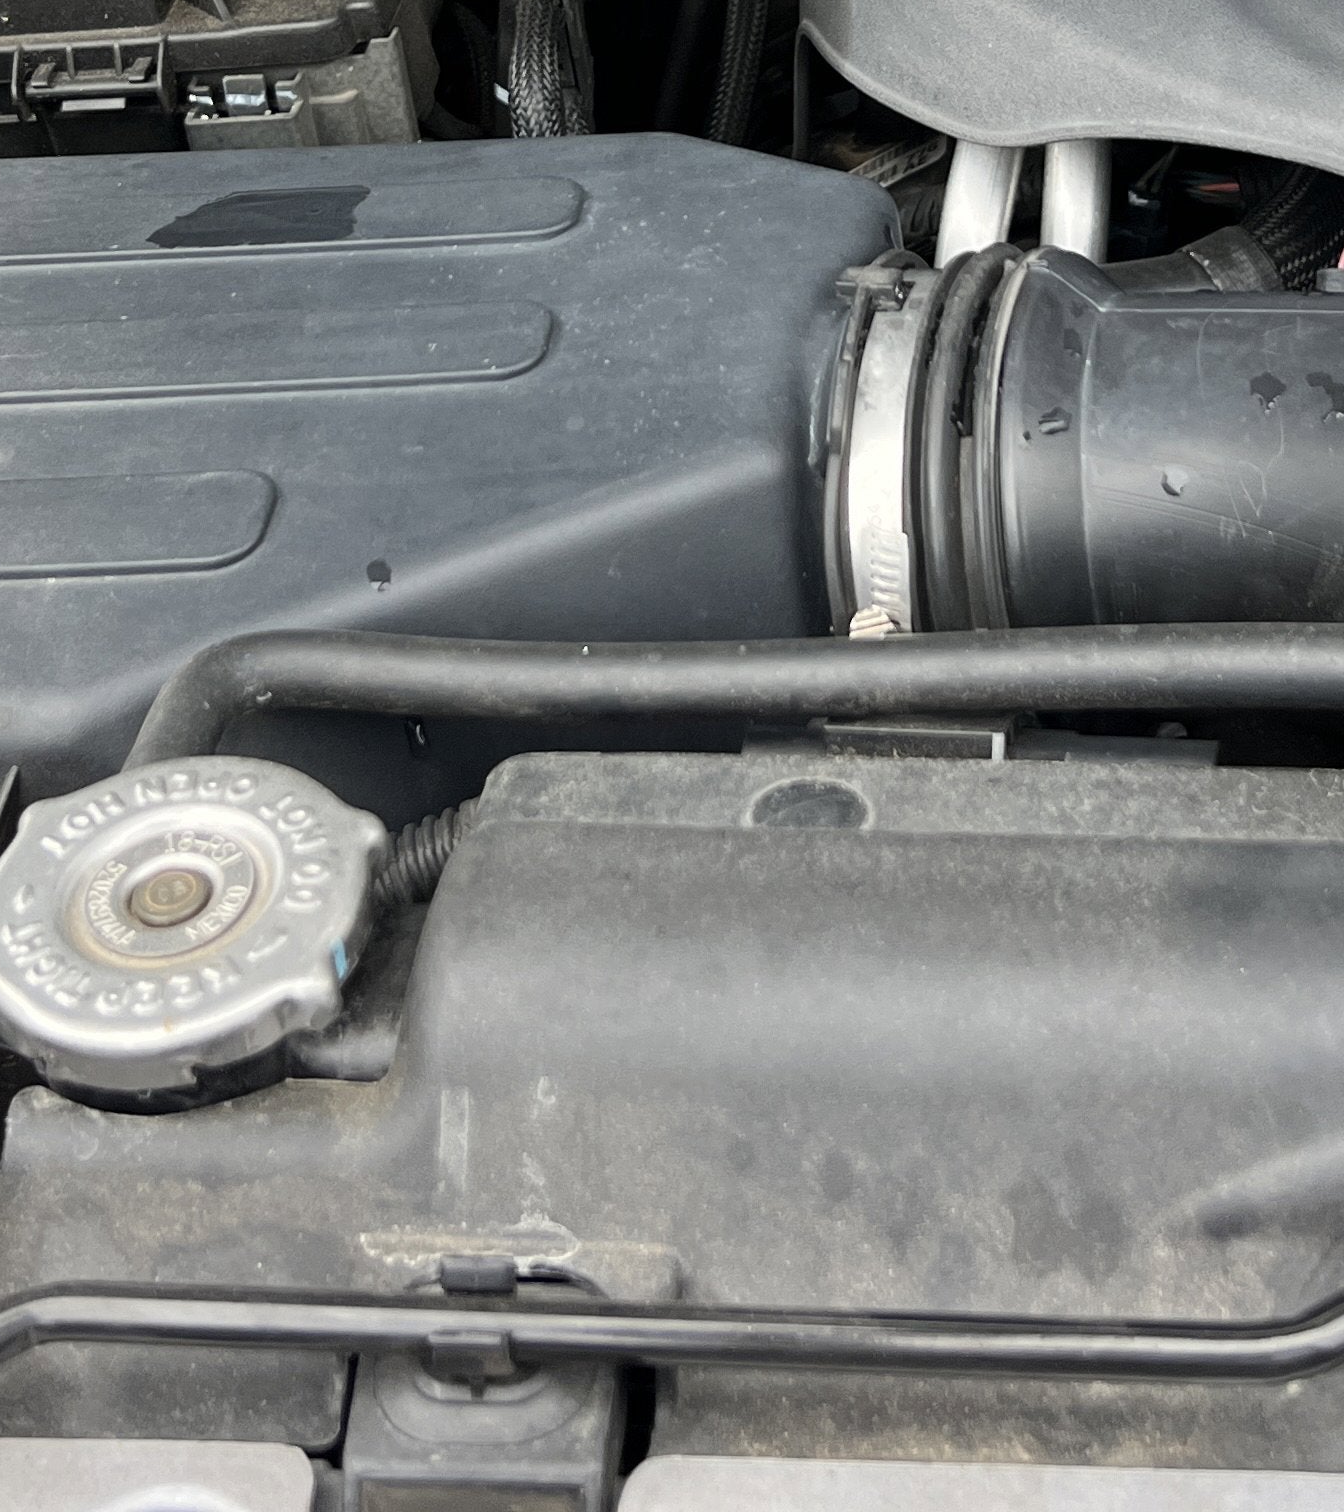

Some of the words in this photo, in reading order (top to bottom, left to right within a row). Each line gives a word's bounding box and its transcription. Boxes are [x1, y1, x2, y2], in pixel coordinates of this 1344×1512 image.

[134, 770, 258, 807] OPEN
[39, 790, 125, 860] HOT
[258, 796, 328, 856] NOT
[184, 885, 248, 940] MEXICO
